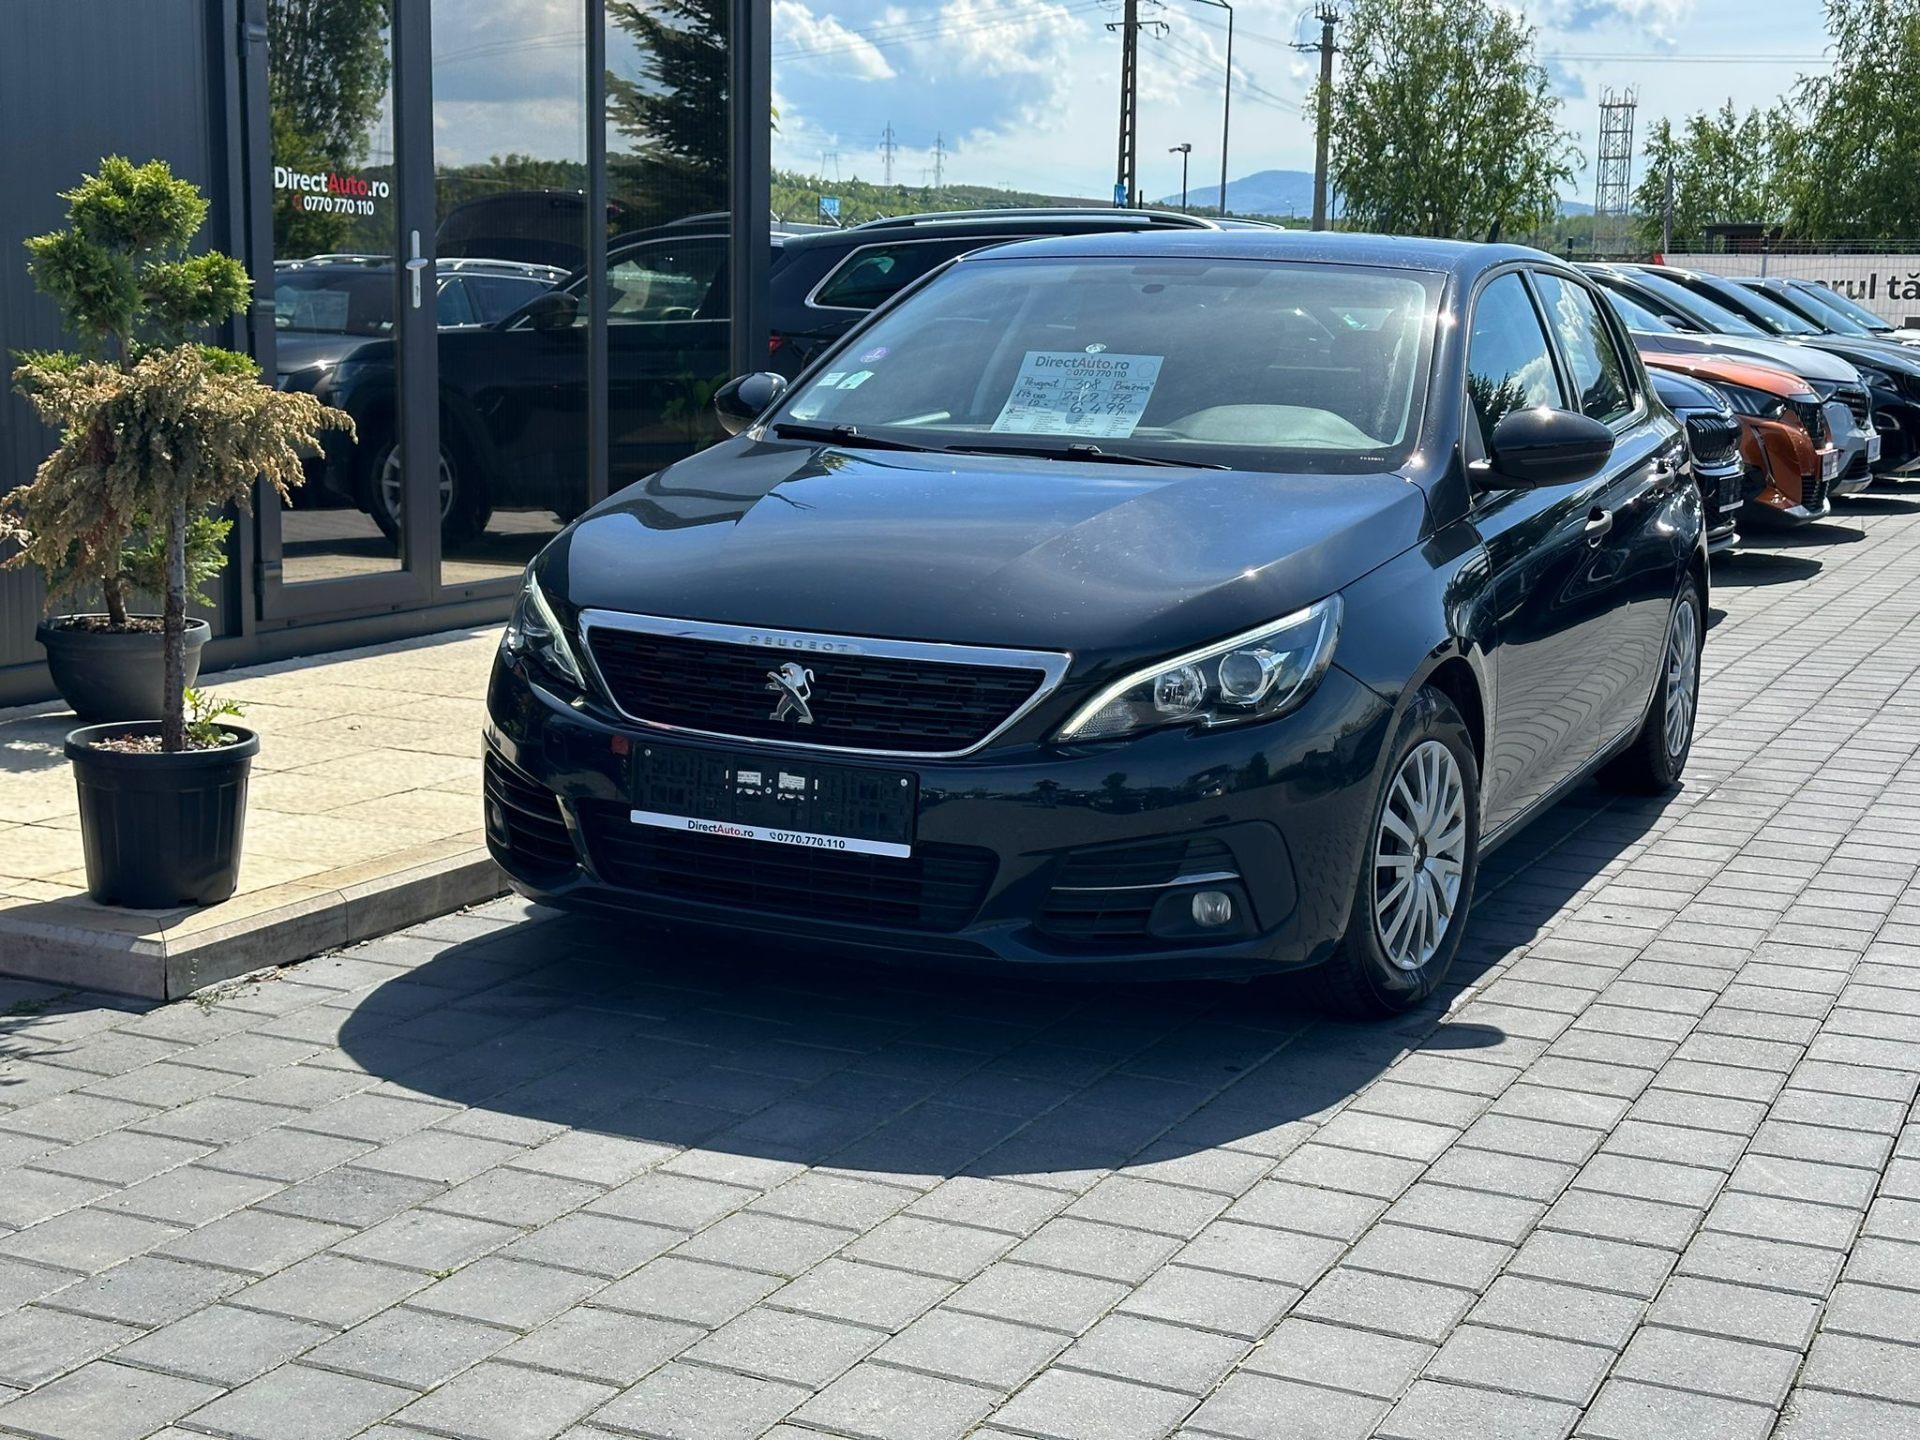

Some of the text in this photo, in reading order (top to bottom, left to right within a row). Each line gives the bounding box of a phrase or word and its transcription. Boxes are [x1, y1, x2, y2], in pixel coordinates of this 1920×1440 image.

[274, 166, 390, 198] DirectAuto.ro
[303, 195, 375, 215] 0770 770 110
[1814, 273, 1877, 300] rul
[1035, 355, 1130, 370] DirectAuto.ro
[1073, 368, 1127, 378] 0770 770 110
[749, 635, 849, 652] PEUGEOT
[687, 819, 846, 851] DirectAuto.ro 0770.770.110
